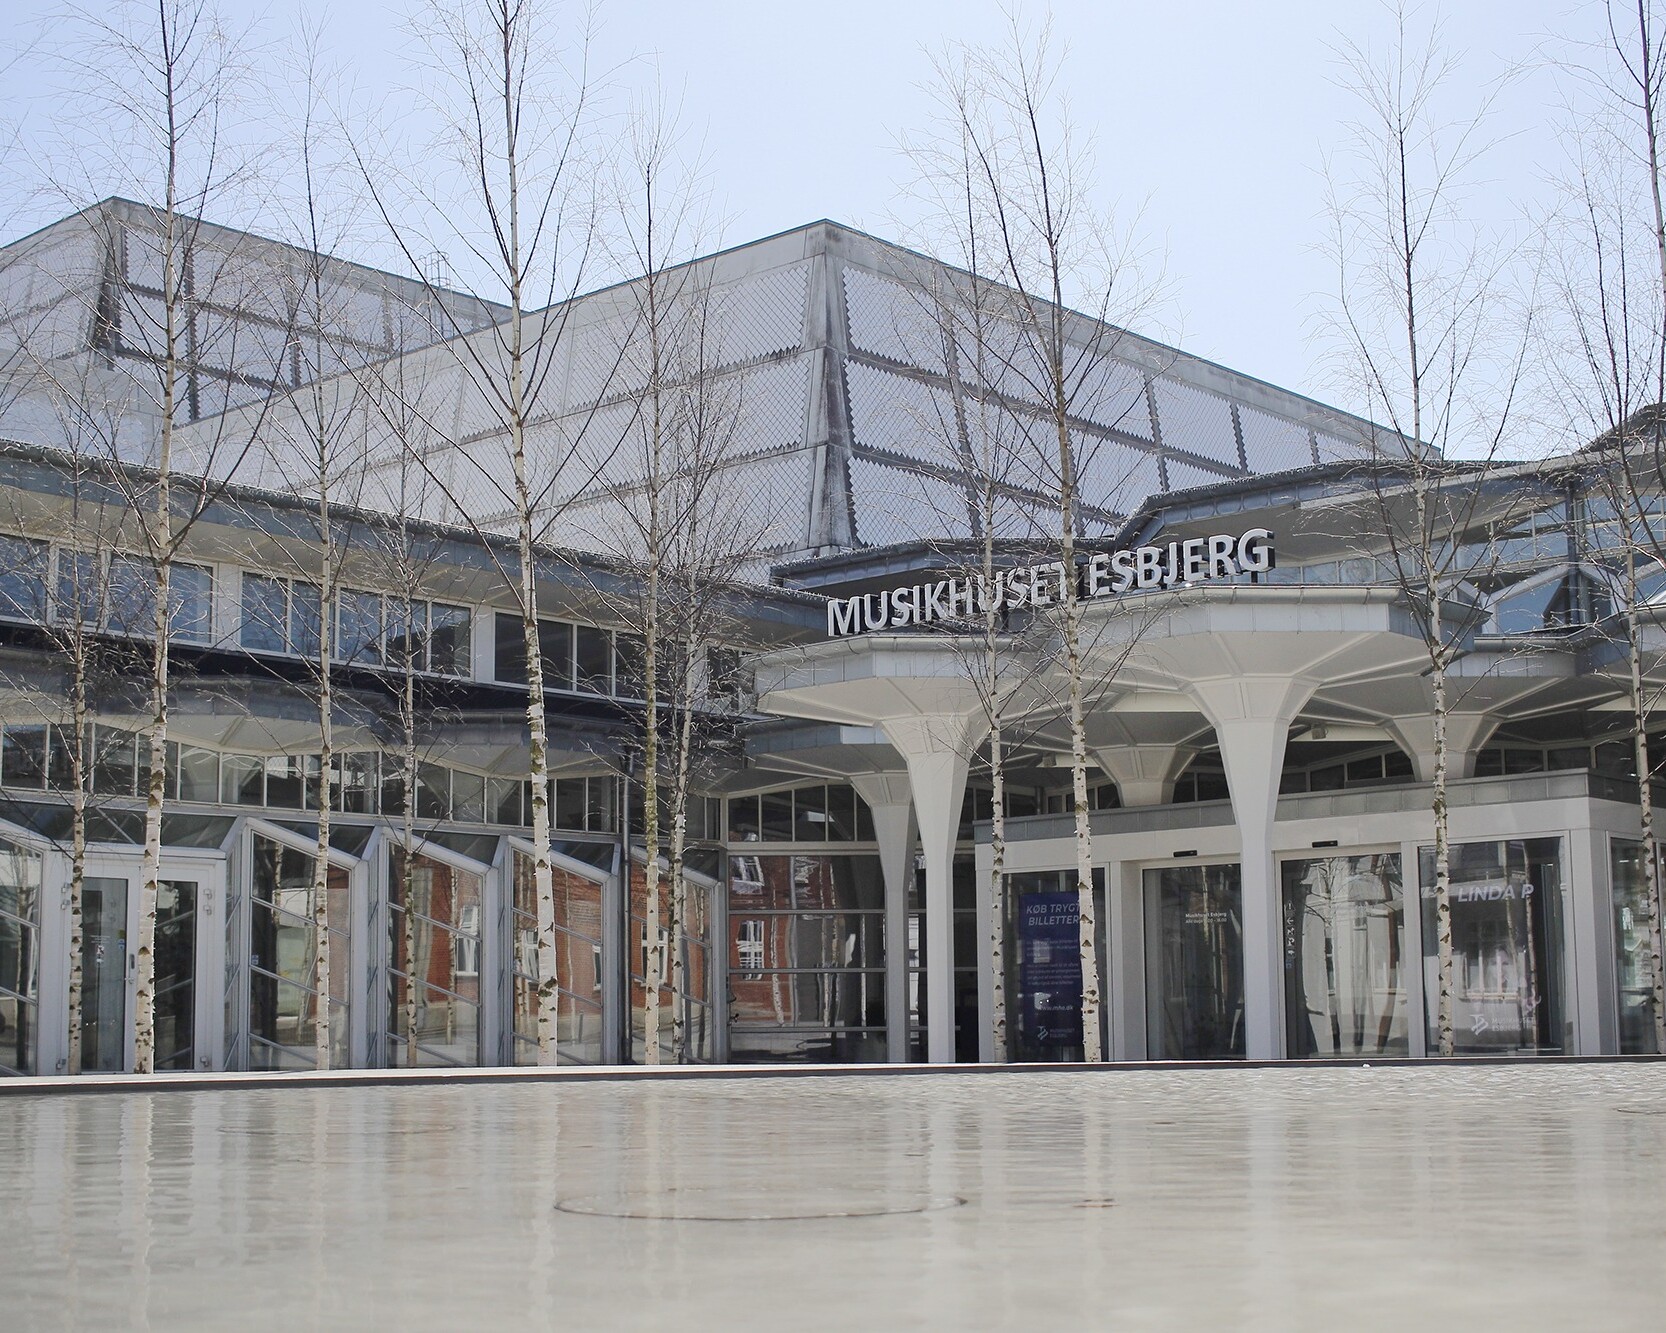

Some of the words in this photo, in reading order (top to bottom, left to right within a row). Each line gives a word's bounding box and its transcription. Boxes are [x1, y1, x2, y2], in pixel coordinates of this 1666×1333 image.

[827, 561, 1077, 637] MUSIKHUSET
[1088, 528, 1275, 598] ESBJERG
[1458, 884, 1515, 902] LINDA
[1521, 883, 1535, 899] P
[1026, 904, 1048, 914] KØB
[1028, 915, 1080, 926] BILLETTER
